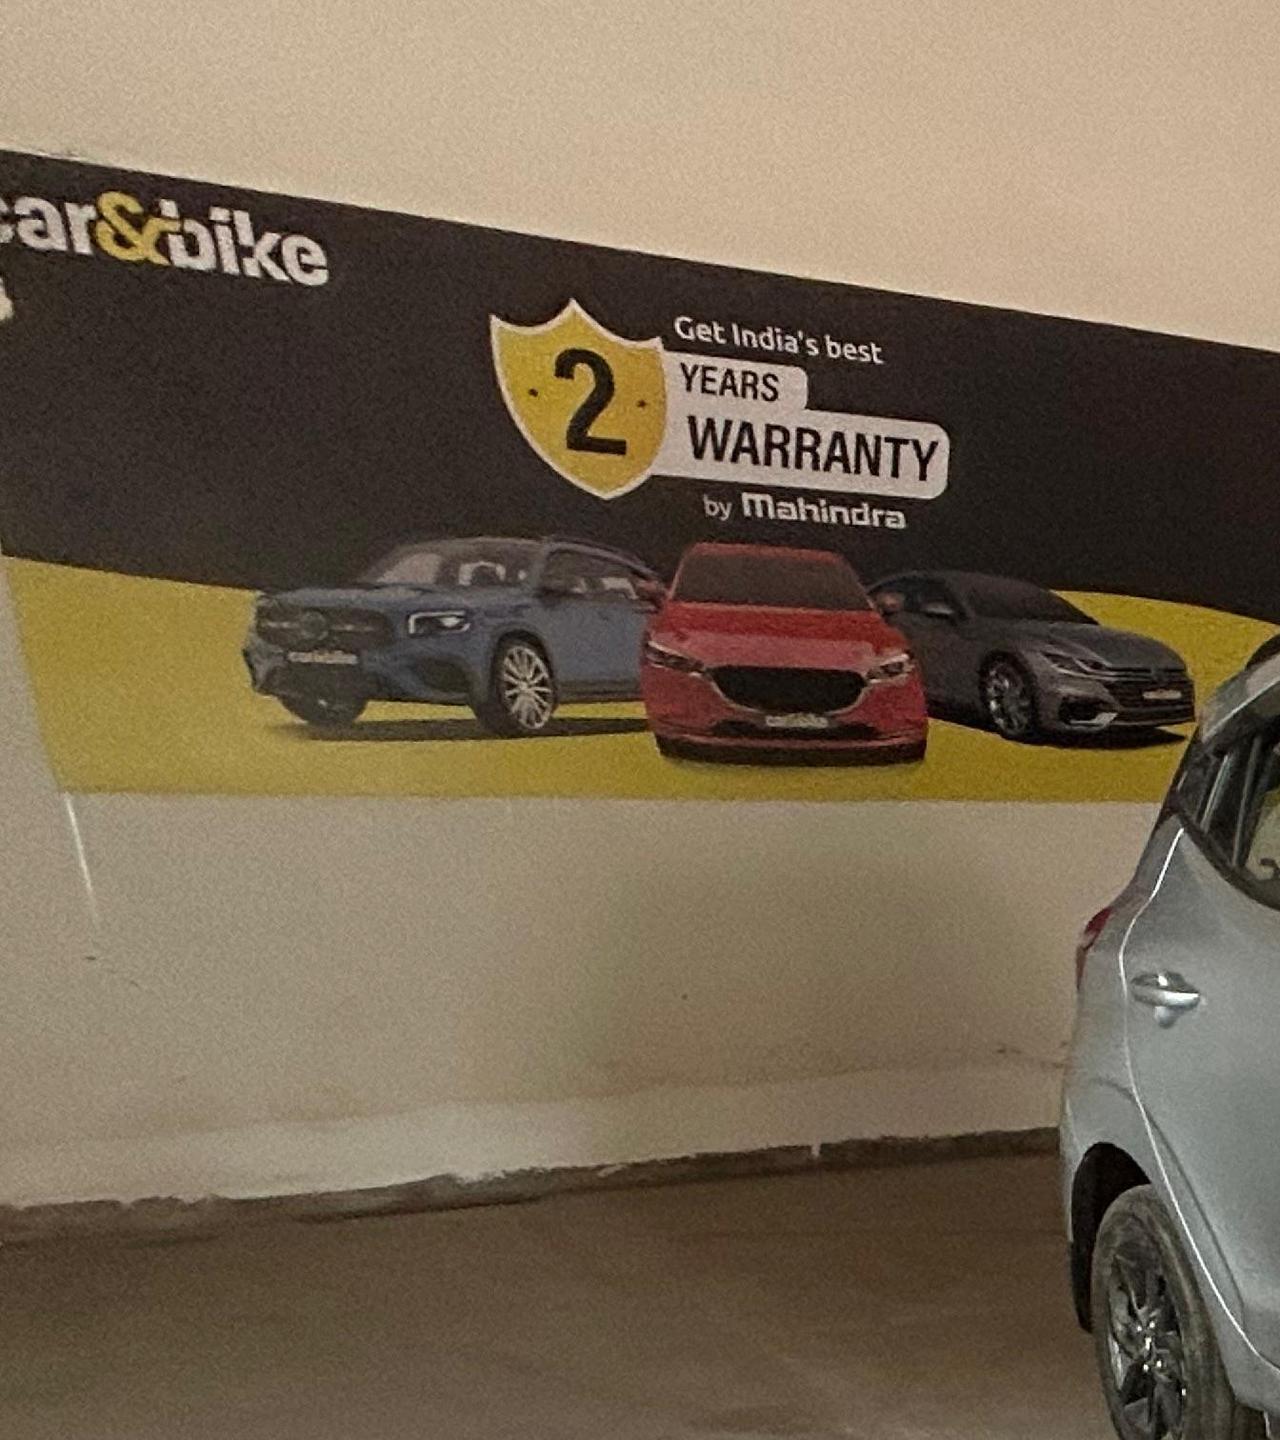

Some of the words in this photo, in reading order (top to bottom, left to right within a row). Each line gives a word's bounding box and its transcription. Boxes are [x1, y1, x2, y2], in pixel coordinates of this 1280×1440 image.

[674, 316, 727, 345] Get
[732, 323, 820, 356] India's
[825, 335, 885, 364] best
[554, 348, 627, 456] 2
[680, 362, 780, 402] YEARS
[687, 415, 939, 481] WARRANTY
[703, 494, 732, 521] by
[741, 492, 907, 530] Mahindra
